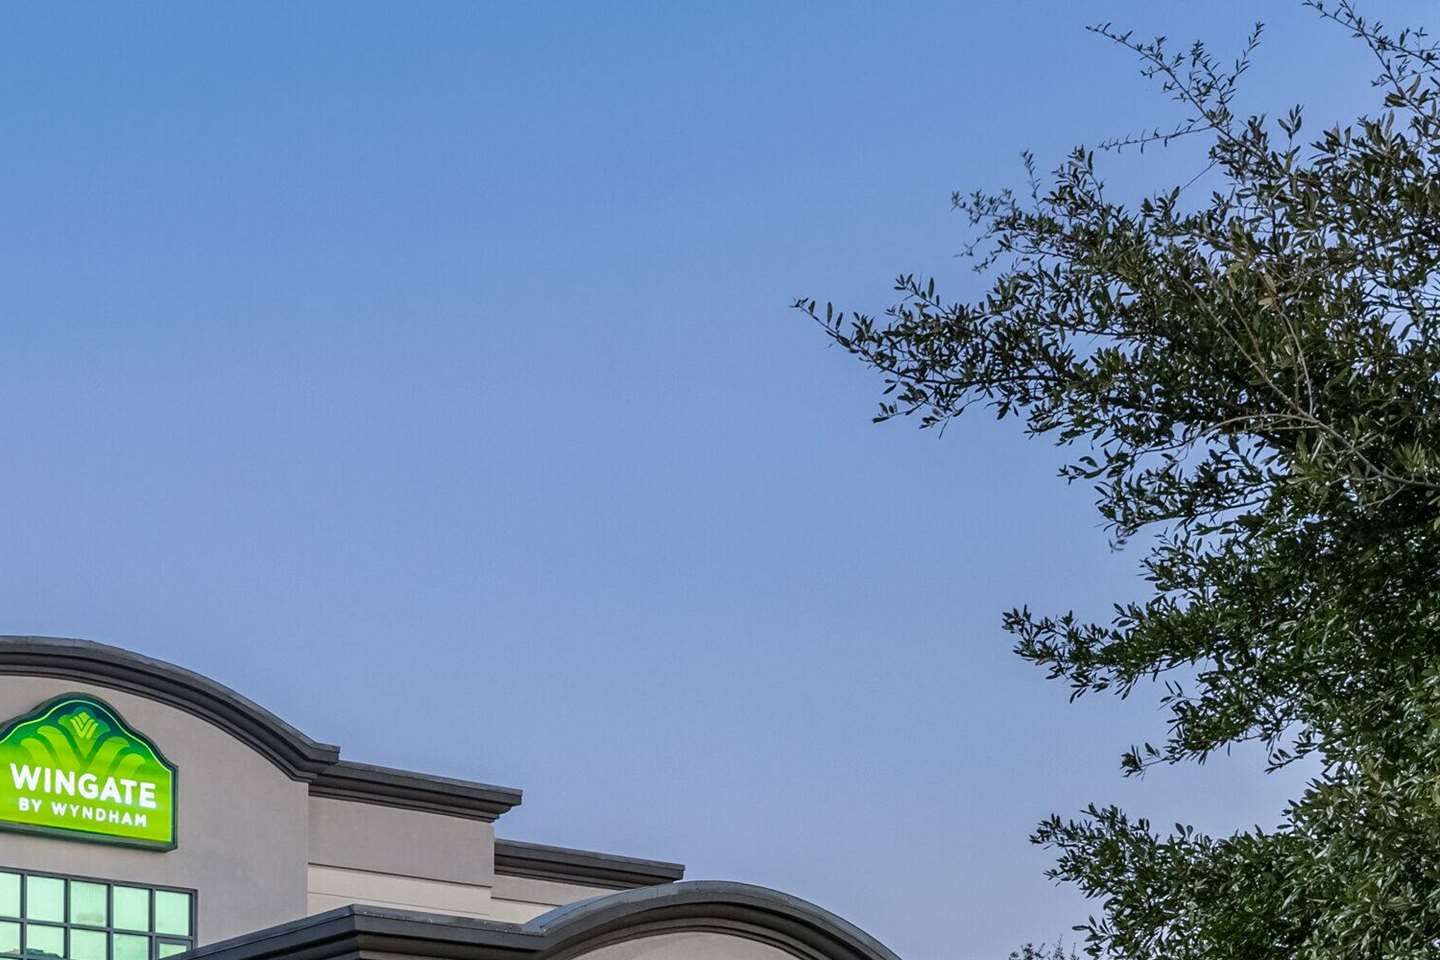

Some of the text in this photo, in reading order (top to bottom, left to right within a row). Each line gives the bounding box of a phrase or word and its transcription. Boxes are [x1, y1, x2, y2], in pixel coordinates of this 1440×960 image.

[10, 763, 157, 809] WINGATE
[18, 797, 148, 827] BY WYNDHAM
